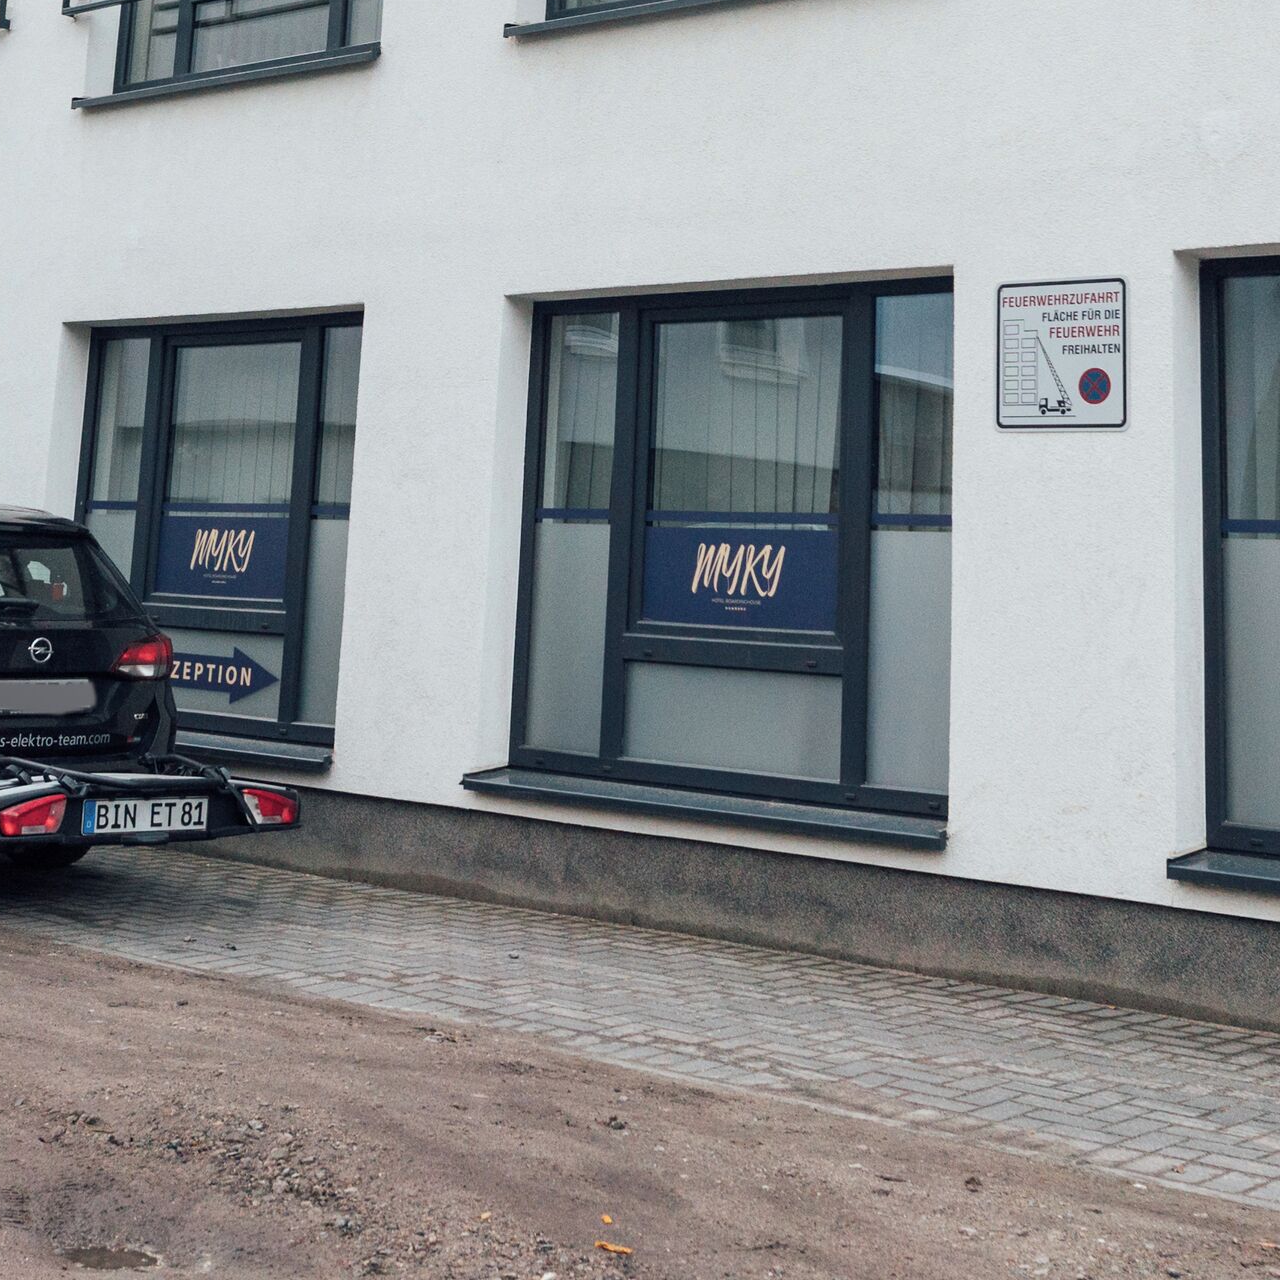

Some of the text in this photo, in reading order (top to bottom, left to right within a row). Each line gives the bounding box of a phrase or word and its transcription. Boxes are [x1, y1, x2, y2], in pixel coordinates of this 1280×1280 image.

[1002, 292, 1120, 308] FEUERWEHRZUFAHRT
[1042, 308, 1120, 322] FLÄCHE FÜR DIE
[1049, 325, 1120, 338] FEUERWEHR
[1062, 344, 1120, 355] FREIHALTEN
[190, 528, 255, 572] MYKY
[691, 542, 786, 597] MYKY
[170, 660, 252, 687] ZEPTION
[96, 801, 205, 829] BIN ET 81
